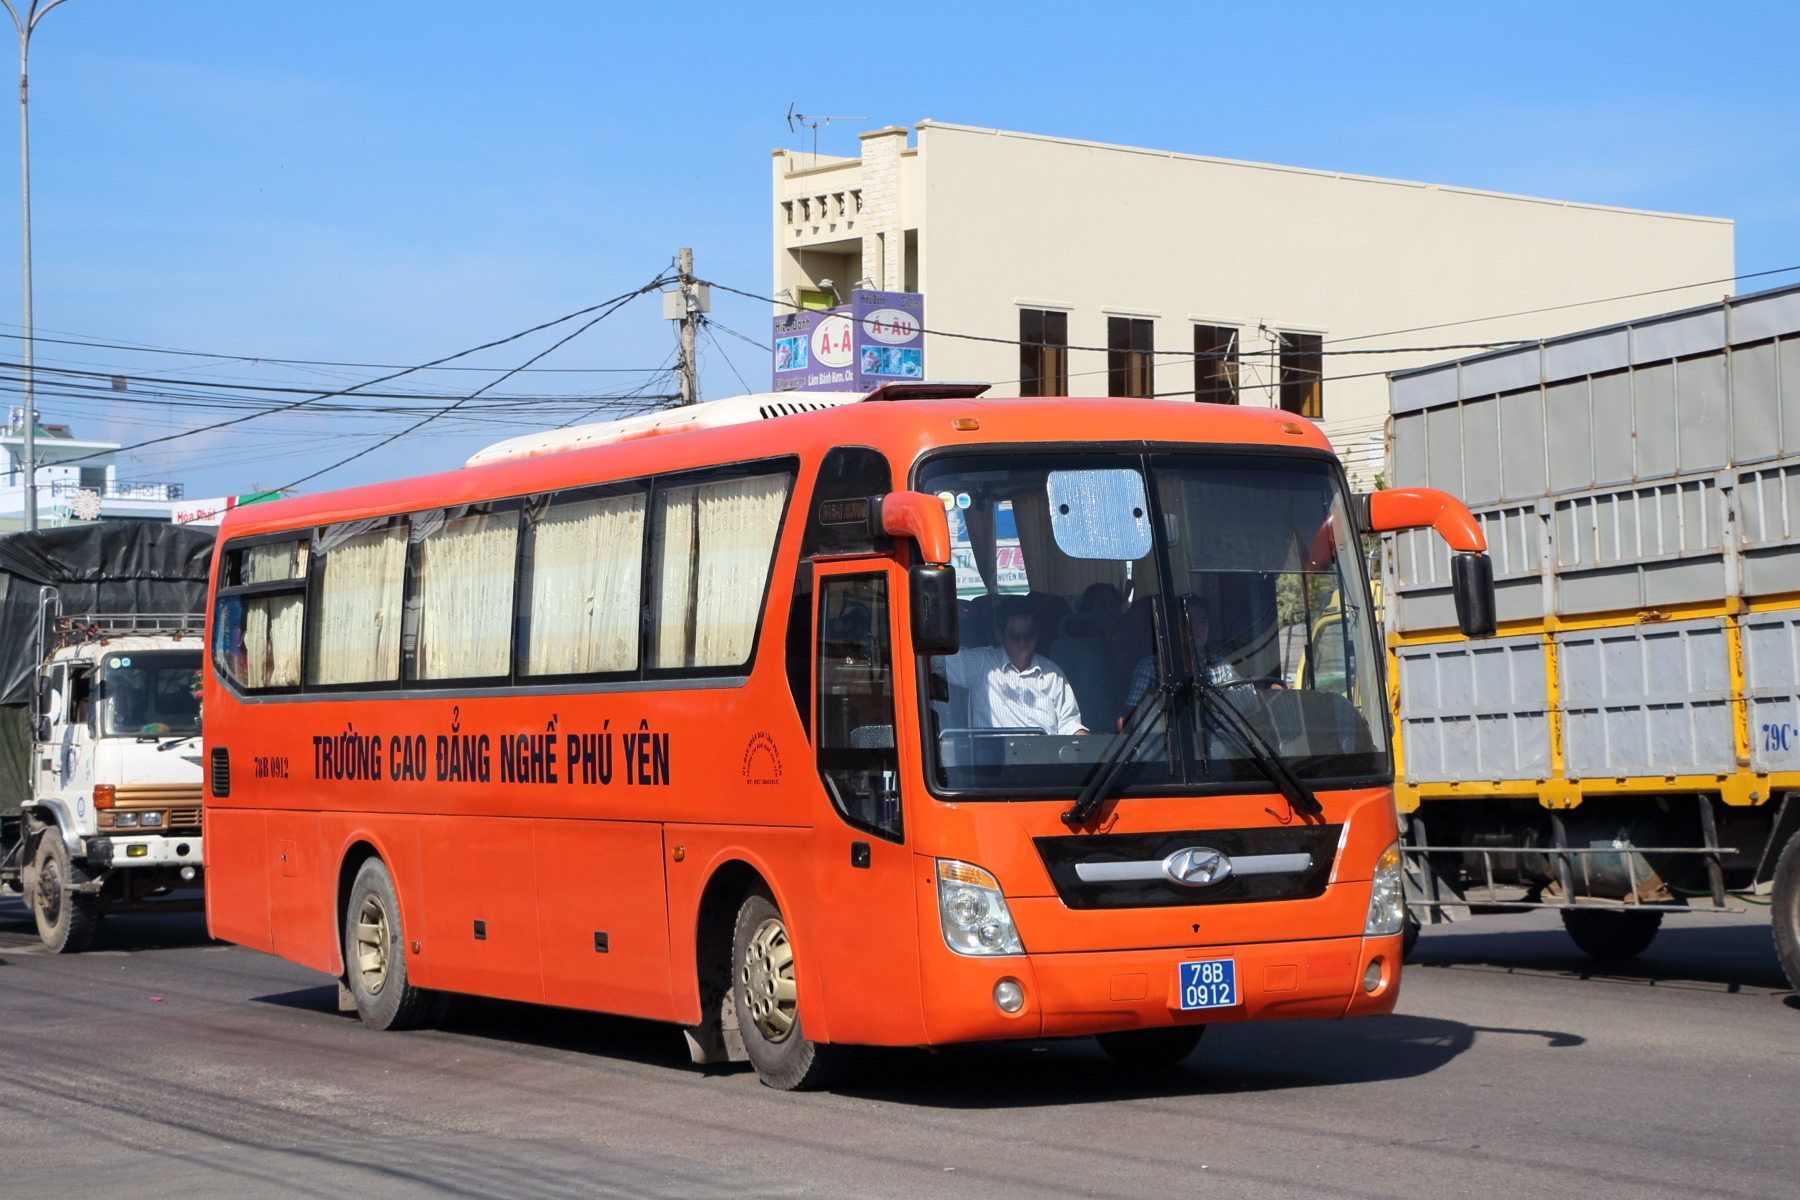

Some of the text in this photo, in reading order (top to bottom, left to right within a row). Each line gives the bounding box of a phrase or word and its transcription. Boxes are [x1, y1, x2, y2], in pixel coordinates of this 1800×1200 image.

[312, 705, 670, 786] TRƯỜNG CAO ĐẲNG NGHỀ PHÚ YÊN
[254, 756, 289, 779] 78B 0912
[1190, 962, 1224, 985] 78B
[1186, 983, 1231, 1006] 0912
